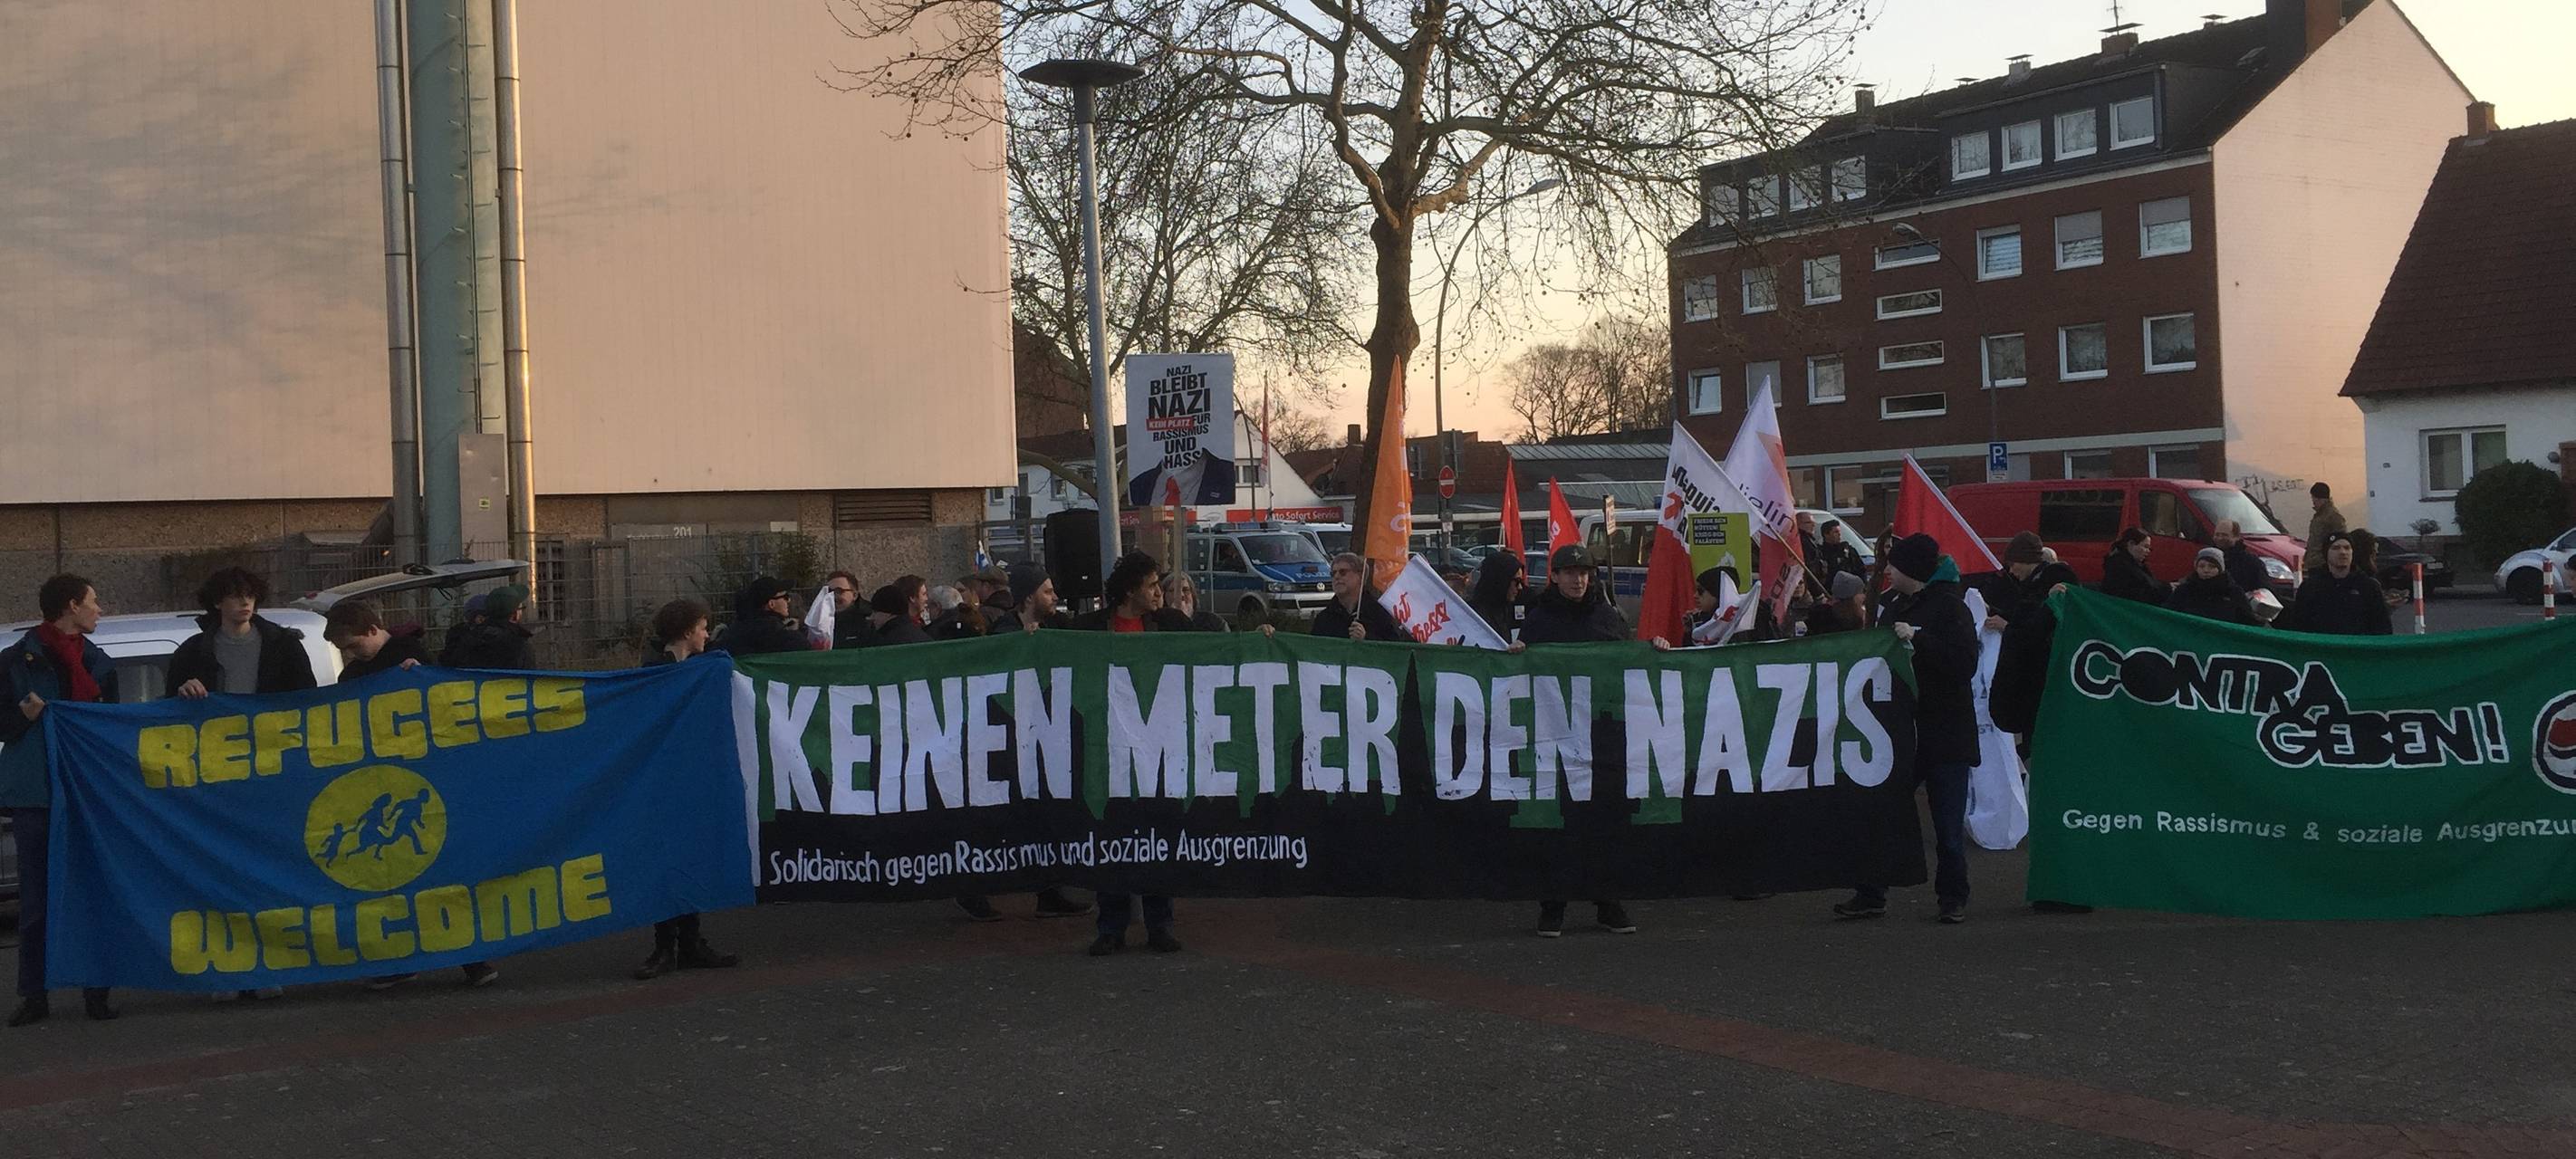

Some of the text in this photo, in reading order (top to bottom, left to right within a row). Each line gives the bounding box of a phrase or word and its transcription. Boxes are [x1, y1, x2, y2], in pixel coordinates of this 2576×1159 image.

[1150, 372, 1207, 396] BLEIBT
[1167, 365, 1191, 377] NAZI
[1149, 388, 1210, 419] NAZI
[1168, 419, 1189, 428] PLATZ
[1165, 436, 1197, 454] UND
[1993, 445, 2004, 464] P
[1164, 450, 1201, 469] HASS
[1286, 510, 1312, 521] Sofort
[674, 526, 692, 537] 201
[2071, 639, 2348, 720] CONTRA
[138, 679, 586, 790] REFUGEES
[766, 656, 1895, 815] KEINEN METER DEN NAZIS
[2256, 702, 2510, 768] GEBEN!
[2062, 809, 2576, 843] Gegen Rassismus & soziale Ausgrenzu
[769, 850, 879, 886] Solidarisch
[885, 851, 952, 886] gegen
[1061, 831, 1094, 867] und
[1100, 827, 1169, 864] soziale
[1176, 829, 1308, 870] Ausgrenzung
[170, 854, 612, 975] WELCOME
